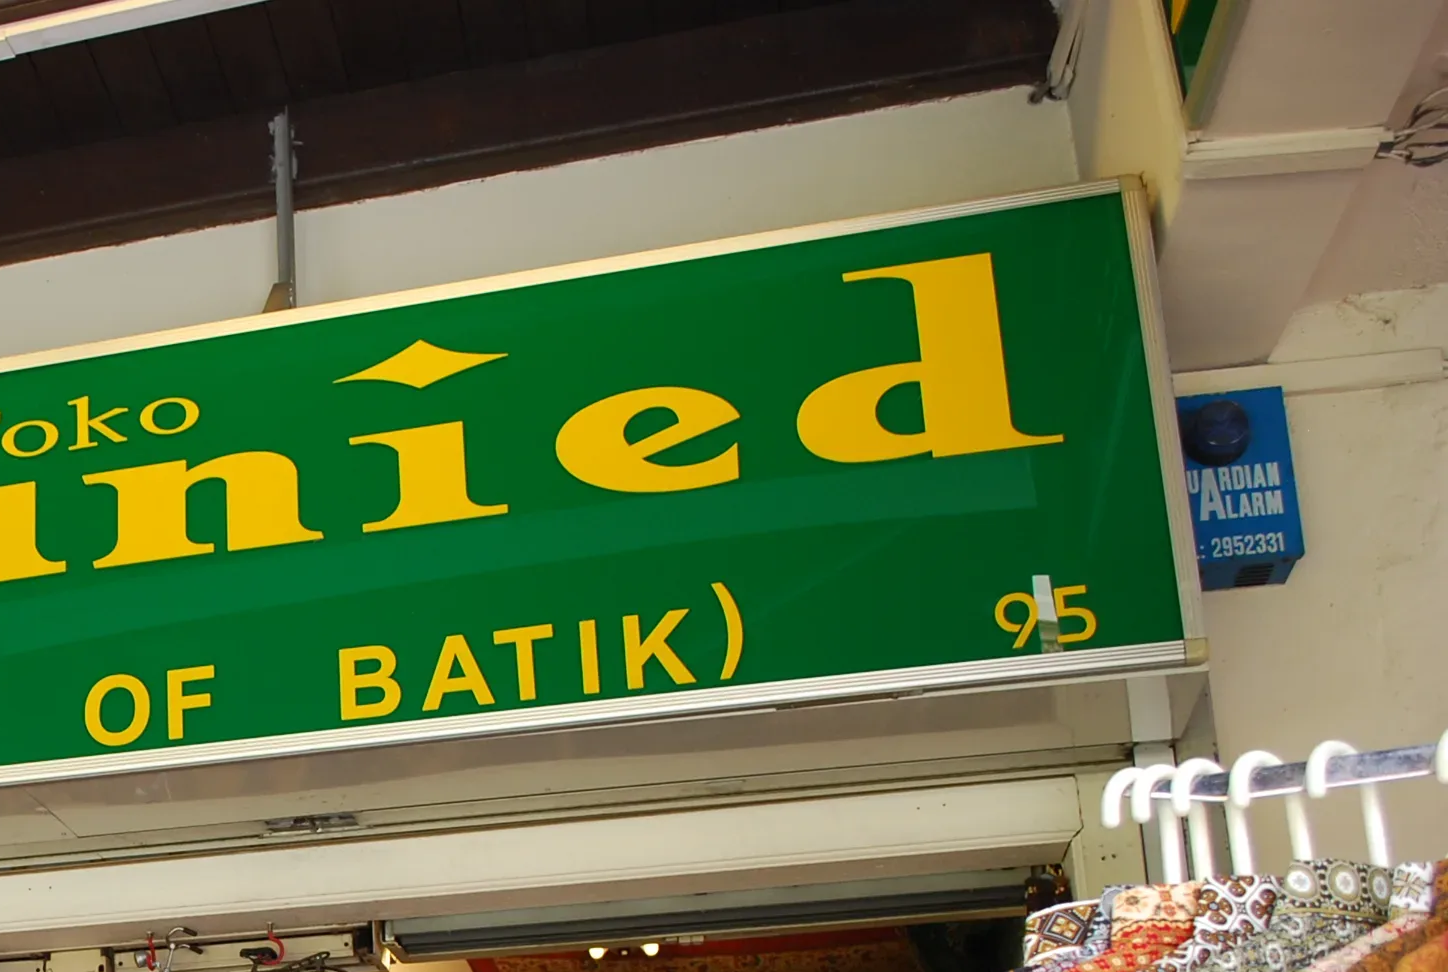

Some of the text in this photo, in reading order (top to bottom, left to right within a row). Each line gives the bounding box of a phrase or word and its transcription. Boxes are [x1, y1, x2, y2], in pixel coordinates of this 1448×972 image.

[1186, 461, 1281, 498] UARDIAN
[1199, 467, 1285, 521] ALARM
[1211, 531, 1285, 558] 2952331
[994, 584, 1097, 649] 95
[84, 664, 215, 748] OF
[338, 582, 744, 721] BATIK)
